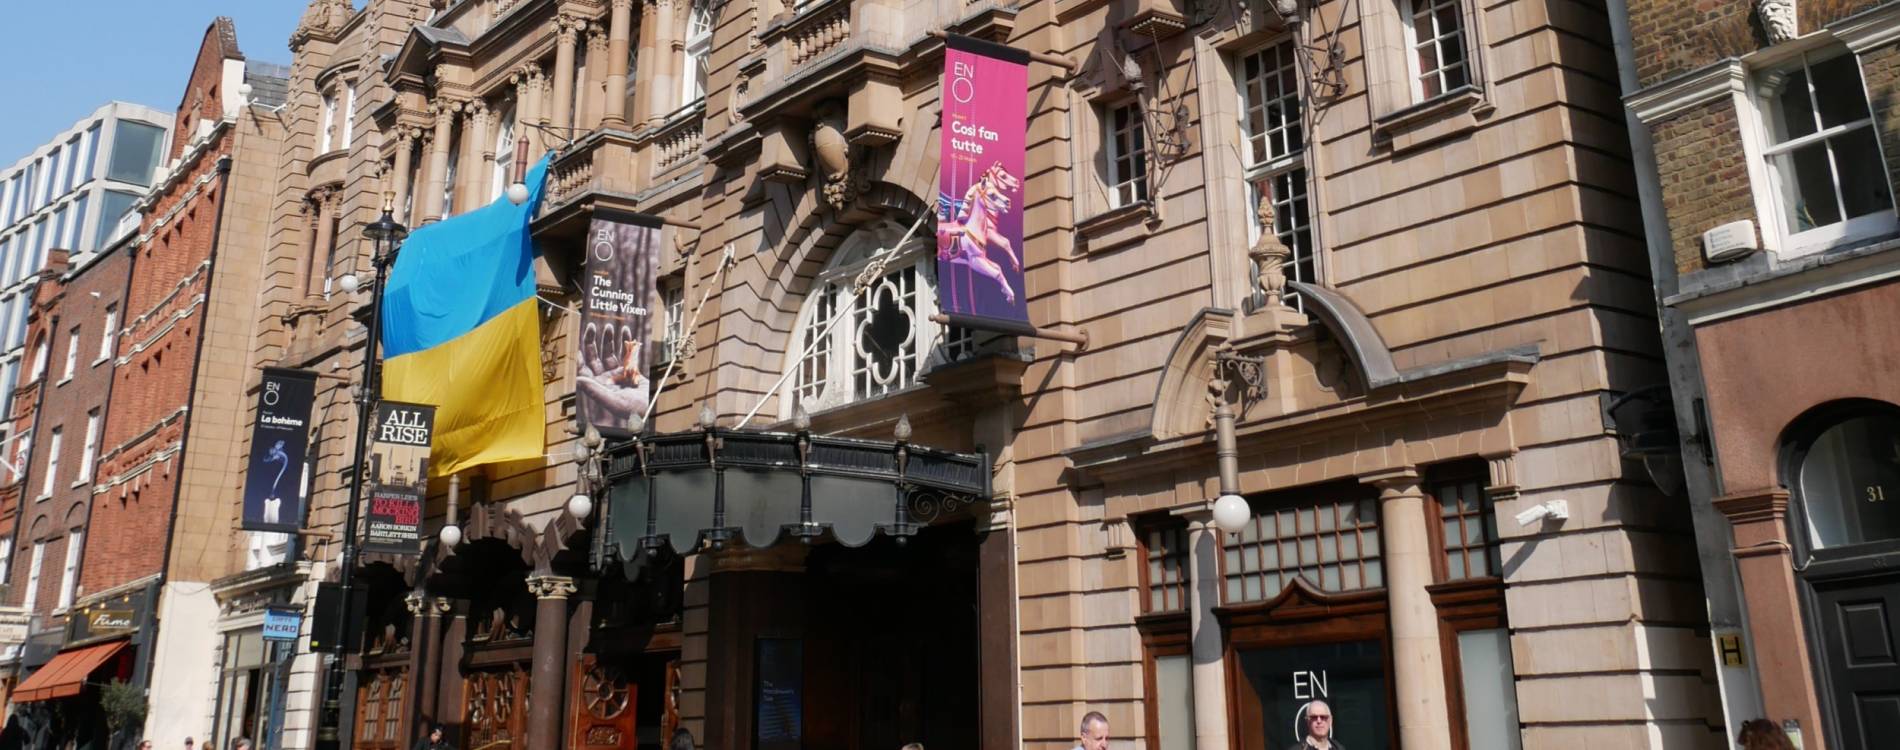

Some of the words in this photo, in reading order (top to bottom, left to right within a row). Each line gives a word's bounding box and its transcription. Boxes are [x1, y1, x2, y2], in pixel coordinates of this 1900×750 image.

[954, 61, 974, 78] EN
[952, 77, 974, 103] O
[978, 126, 998, 141] fan
[951, 137, 983, 154] tutte
[597, 229, 615, 242] EN
[593, 275, 612, 287] The
[591, 286, 634, 304] Cunning
[590, 299, 618, 312] Little
[619, 302, 647, 316] Vixen
[266, 381, 280, 391] EN
[261, 415, 271, 423] La
[385, 409, 426, 429] ALL
[380, 424, 428, 445] RISE
[1866, 485, 1884, 502] 31
[265, 624, 297, 633] NERO
[1720, 636, 1743, 666] H
[1293, 669, 1328, 699] EN
